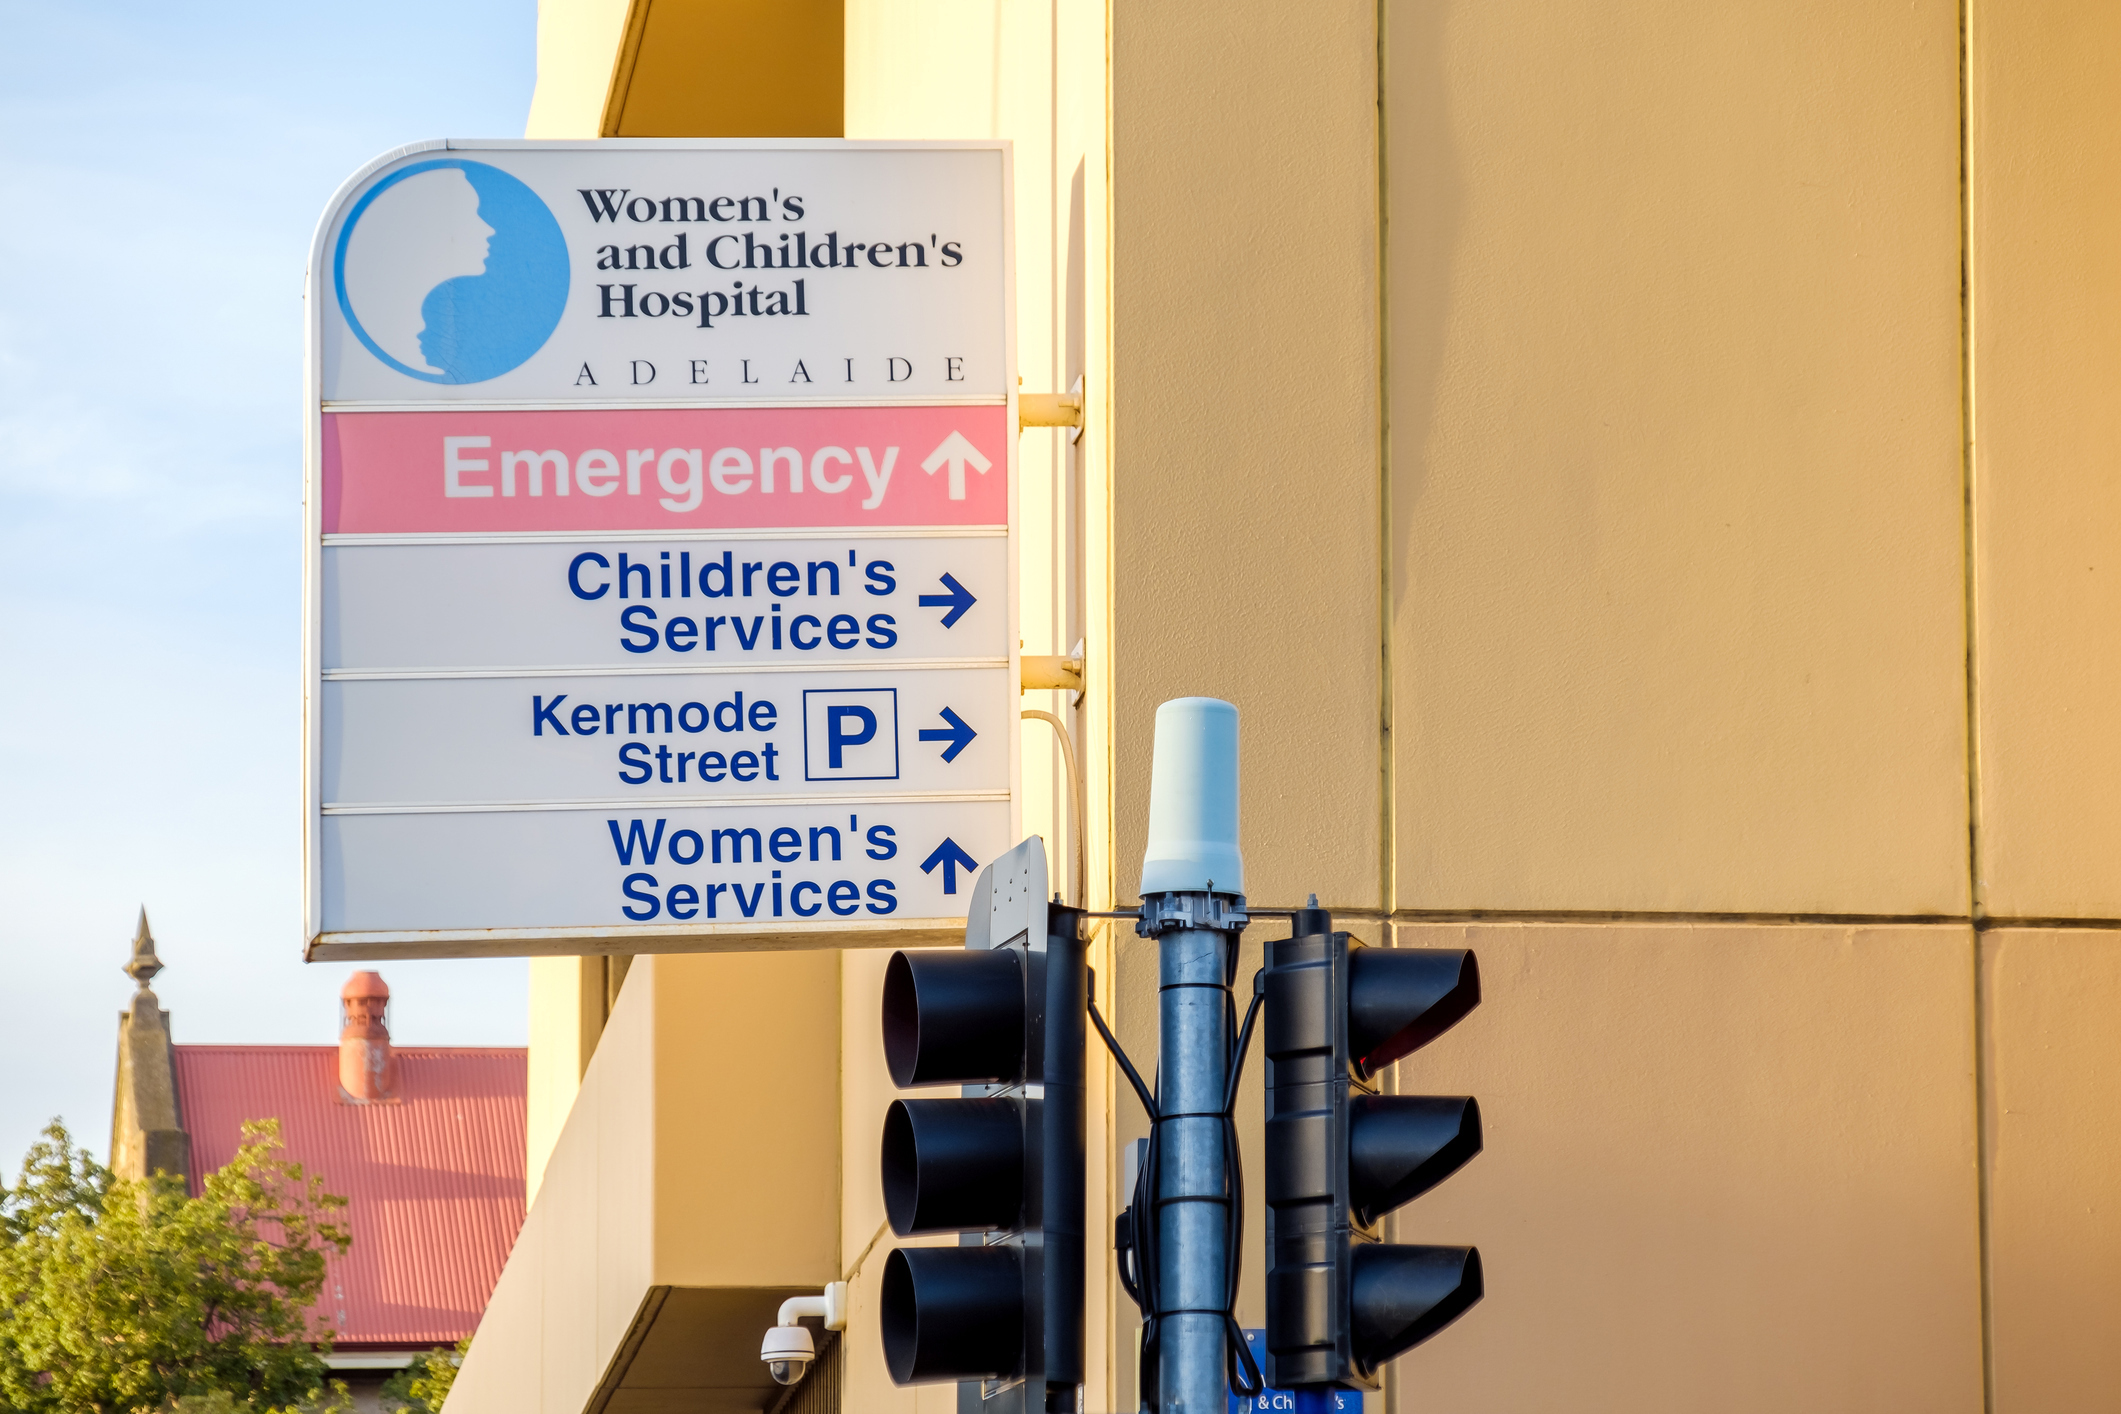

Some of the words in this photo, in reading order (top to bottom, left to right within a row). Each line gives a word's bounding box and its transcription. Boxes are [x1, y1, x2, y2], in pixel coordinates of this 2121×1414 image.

[577, 187, 805, 224] Women's
[597, 232, 692, 271] and
[706, 230, 963, 270] Children's
[597, 278, 810, 329] Hospital
[574, 356, 965, 386] ADELAIDE
[444, 436, 899, 512] Emergency
[568, 550, 897, 601] Children's
[620, 603, 898, 654] Services
[533, 691, 778, 737] Kermode
[828, 706, 878, 769] P
[619, 742, 780, 785] Street
[607, 814, 898, 866] Women's
[622, 870, 898, 922] Services
[1258, 1395, 1269, 1410] &
